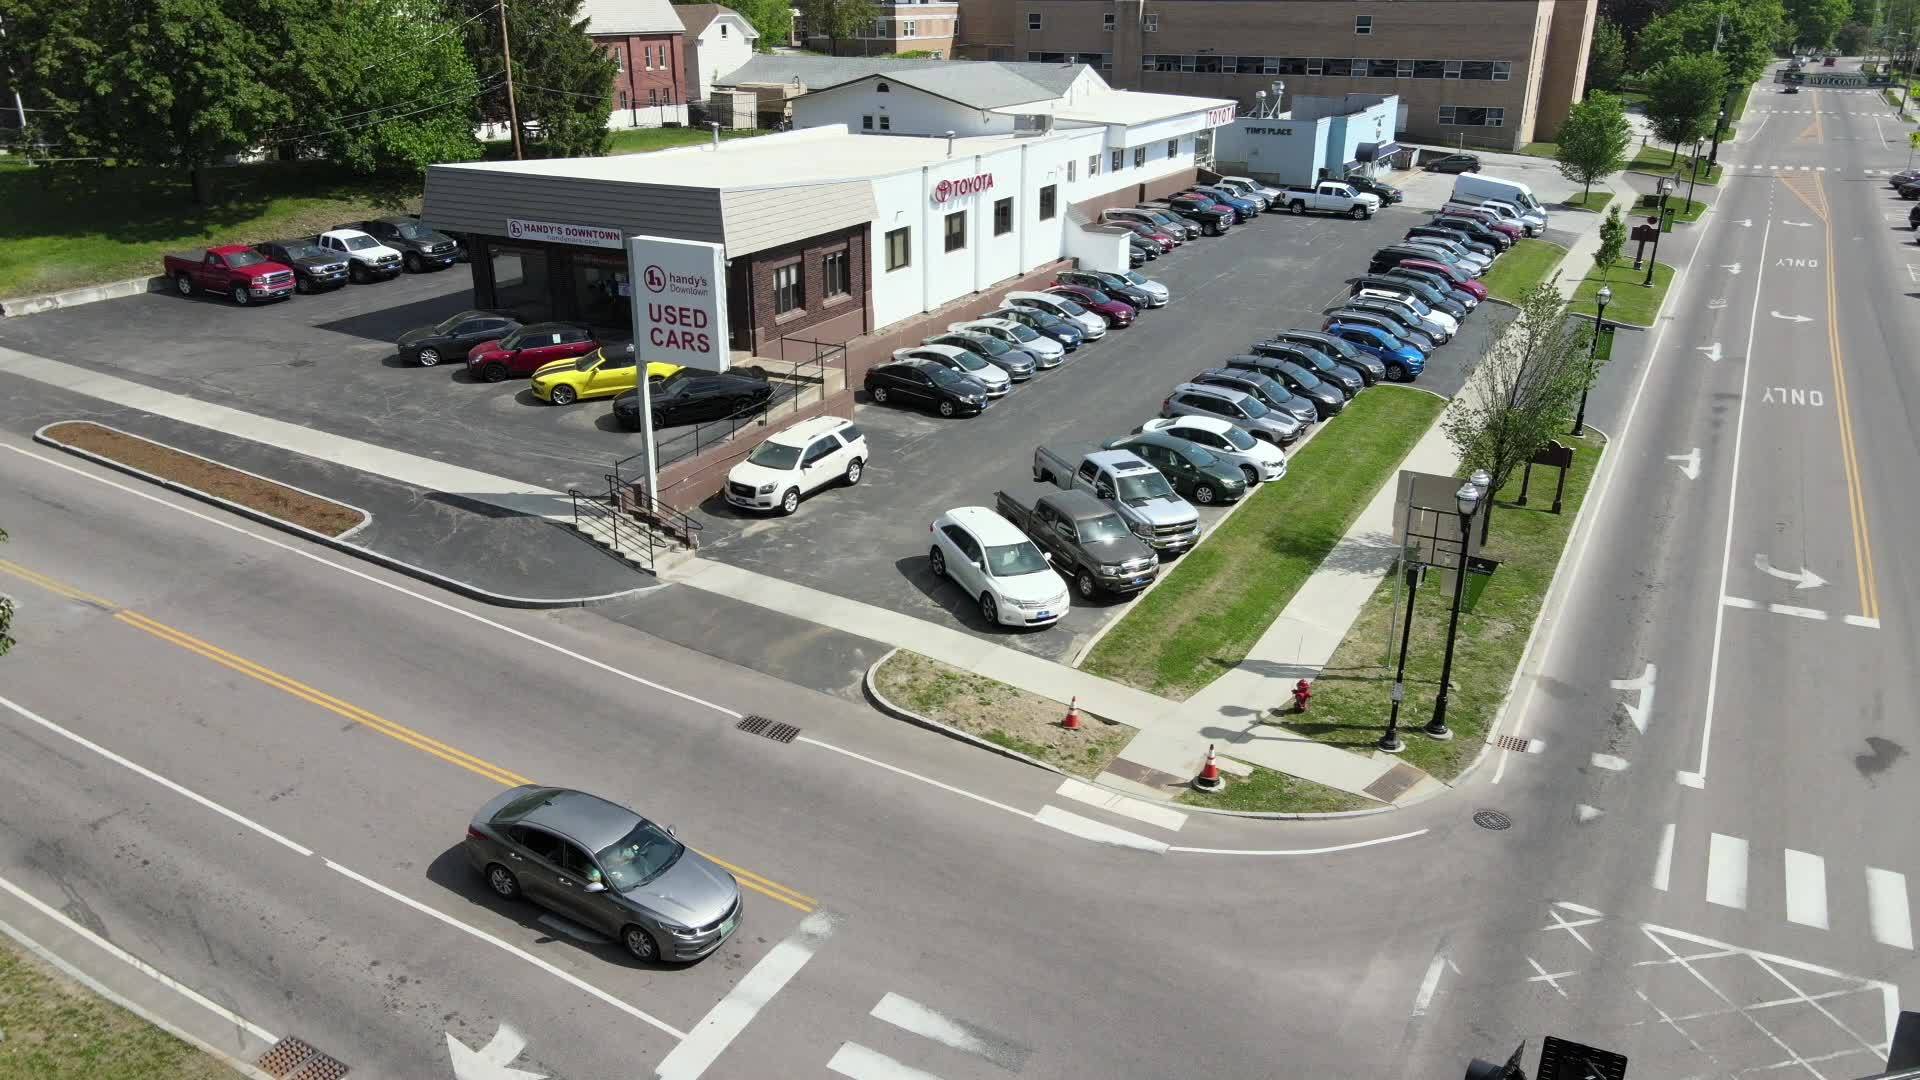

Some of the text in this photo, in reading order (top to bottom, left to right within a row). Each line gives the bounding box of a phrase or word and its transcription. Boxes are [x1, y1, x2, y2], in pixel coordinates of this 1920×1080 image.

[1208, 106, 1236, 126] TOYOTA
[1268, 128, 1292, 136] PLACE
[954, 172, 994, 197] TOYOTA
[523, 223, 620, 241] HANDY'S DOWNTOWN
[1775, 258, 1818, 268] ONLY
[669, 272, 708, 288] handy's
[670, 284, 709, 297] Downtown
[648, 303, 708, 329] USED
[650, 327, 711, 354] CARS
[1761, 386, 1824, 407] ONLY
